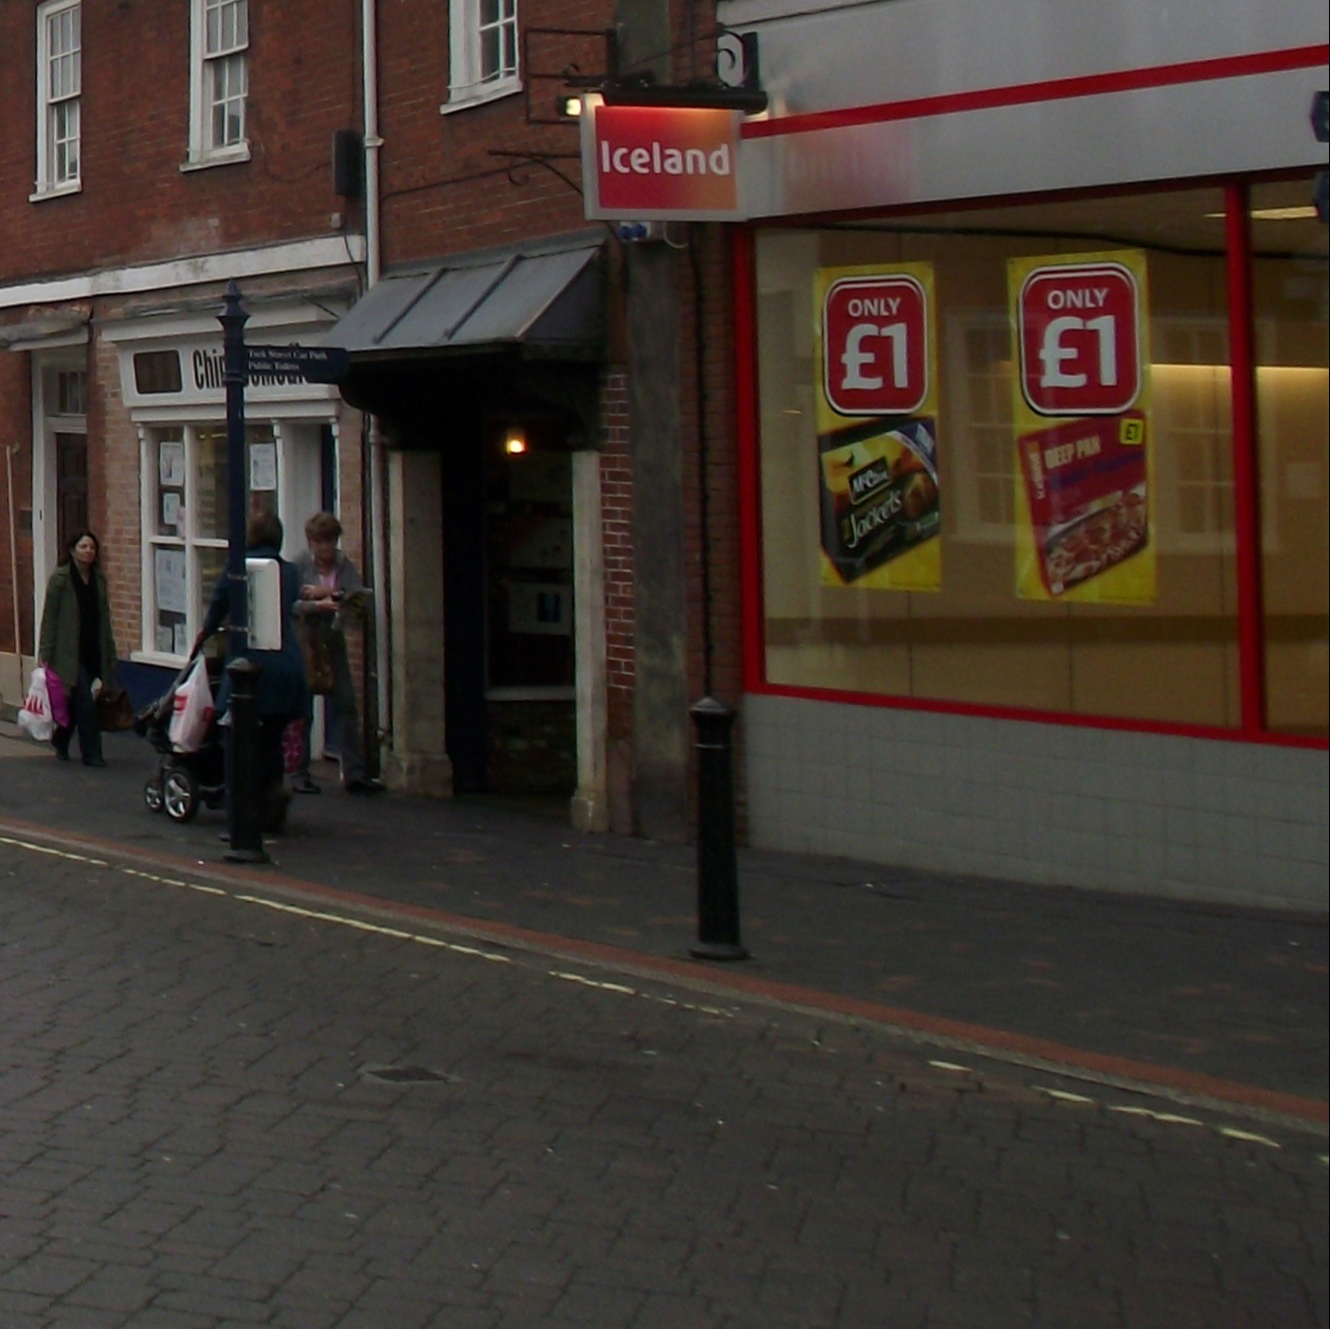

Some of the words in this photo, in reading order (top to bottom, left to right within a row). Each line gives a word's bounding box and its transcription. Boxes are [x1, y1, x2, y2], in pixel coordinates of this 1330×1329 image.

[601, 140, 731, 175] Iceland
[848, 297, 902, 317] ONLY
[1047, 288, 1108, 310] ONLY
[292, 351, 308, 360] Car
[309, 351, 328, 361] Park
[841, 323, 909, 390] £1
[1038, 315, 1118, 388] £1
